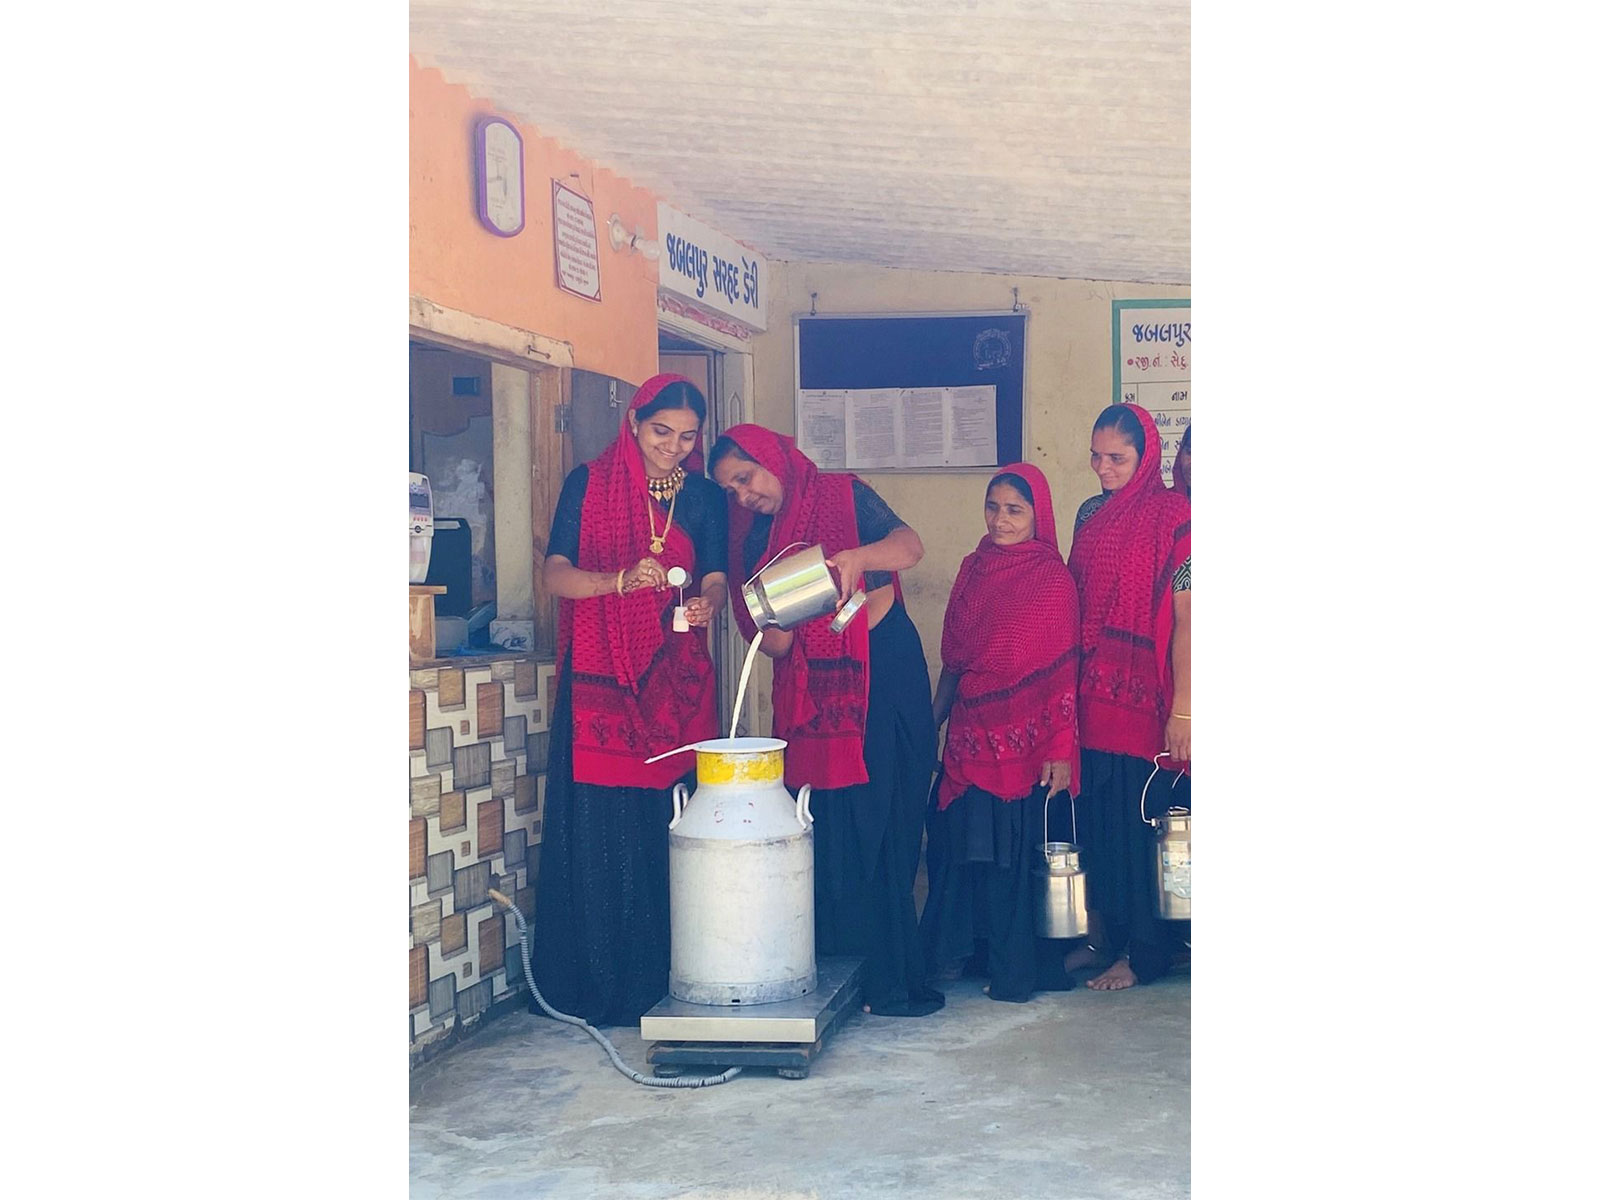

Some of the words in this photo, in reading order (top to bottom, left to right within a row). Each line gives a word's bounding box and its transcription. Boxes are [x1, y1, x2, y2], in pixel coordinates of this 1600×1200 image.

[666, 232, 708, 298] જબલપુર
[713, 255, 740, 305] સરહદ
[741, 256, 759, 310] ડેરી
[1132, 322, 1191, 348] જબલપુર
[1171, 390, 1188, 401] નામ
